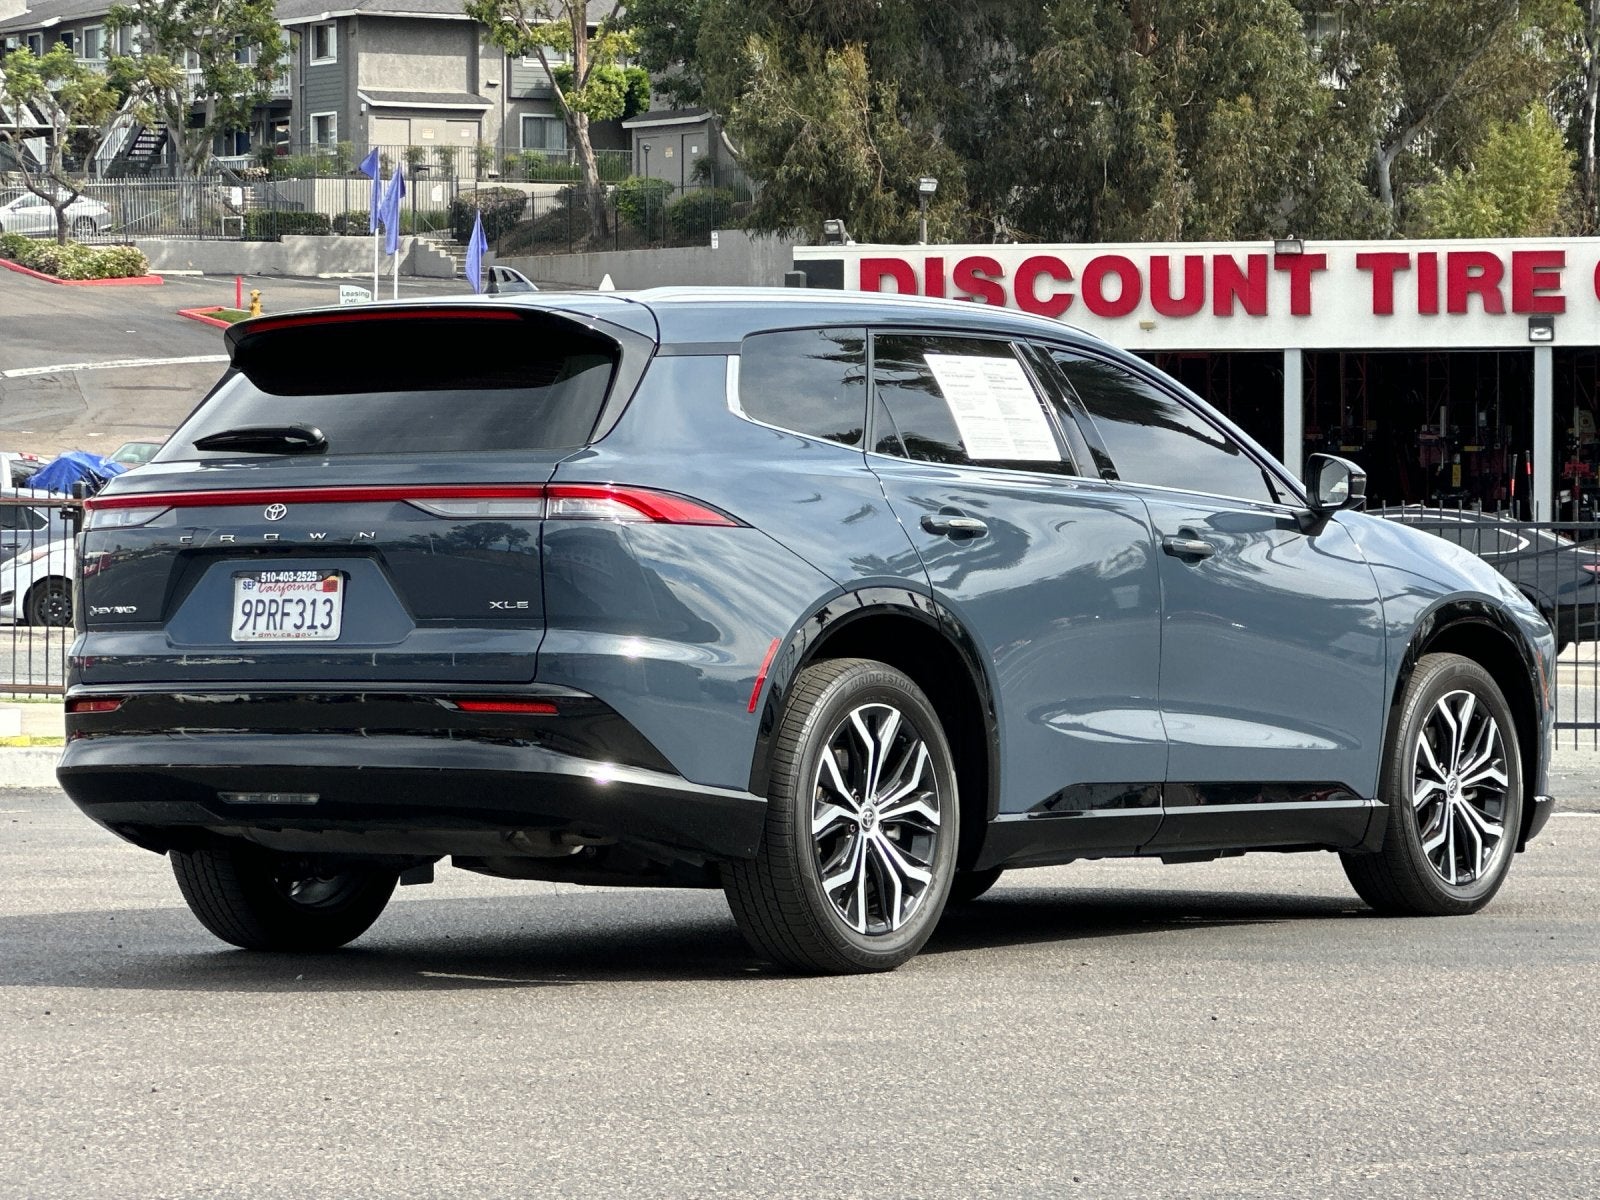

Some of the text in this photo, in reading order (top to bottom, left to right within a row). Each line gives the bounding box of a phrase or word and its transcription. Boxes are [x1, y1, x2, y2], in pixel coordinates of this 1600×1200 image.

[860, 253, 1327, 318] DISCOUNT
[1356, 251, 1566, 315] TIRE
[341, 290, 370, 299] Leasing
[179, 530, 376, 545] CROWN
[260, 571, 318, 583] 510-403-2525
[242, 580, 256, 590] SEP
[258, 581, 323, 597] California
[489, 600, 529, 610] XLE
[238, 597, 334, 631] 9PRF313
